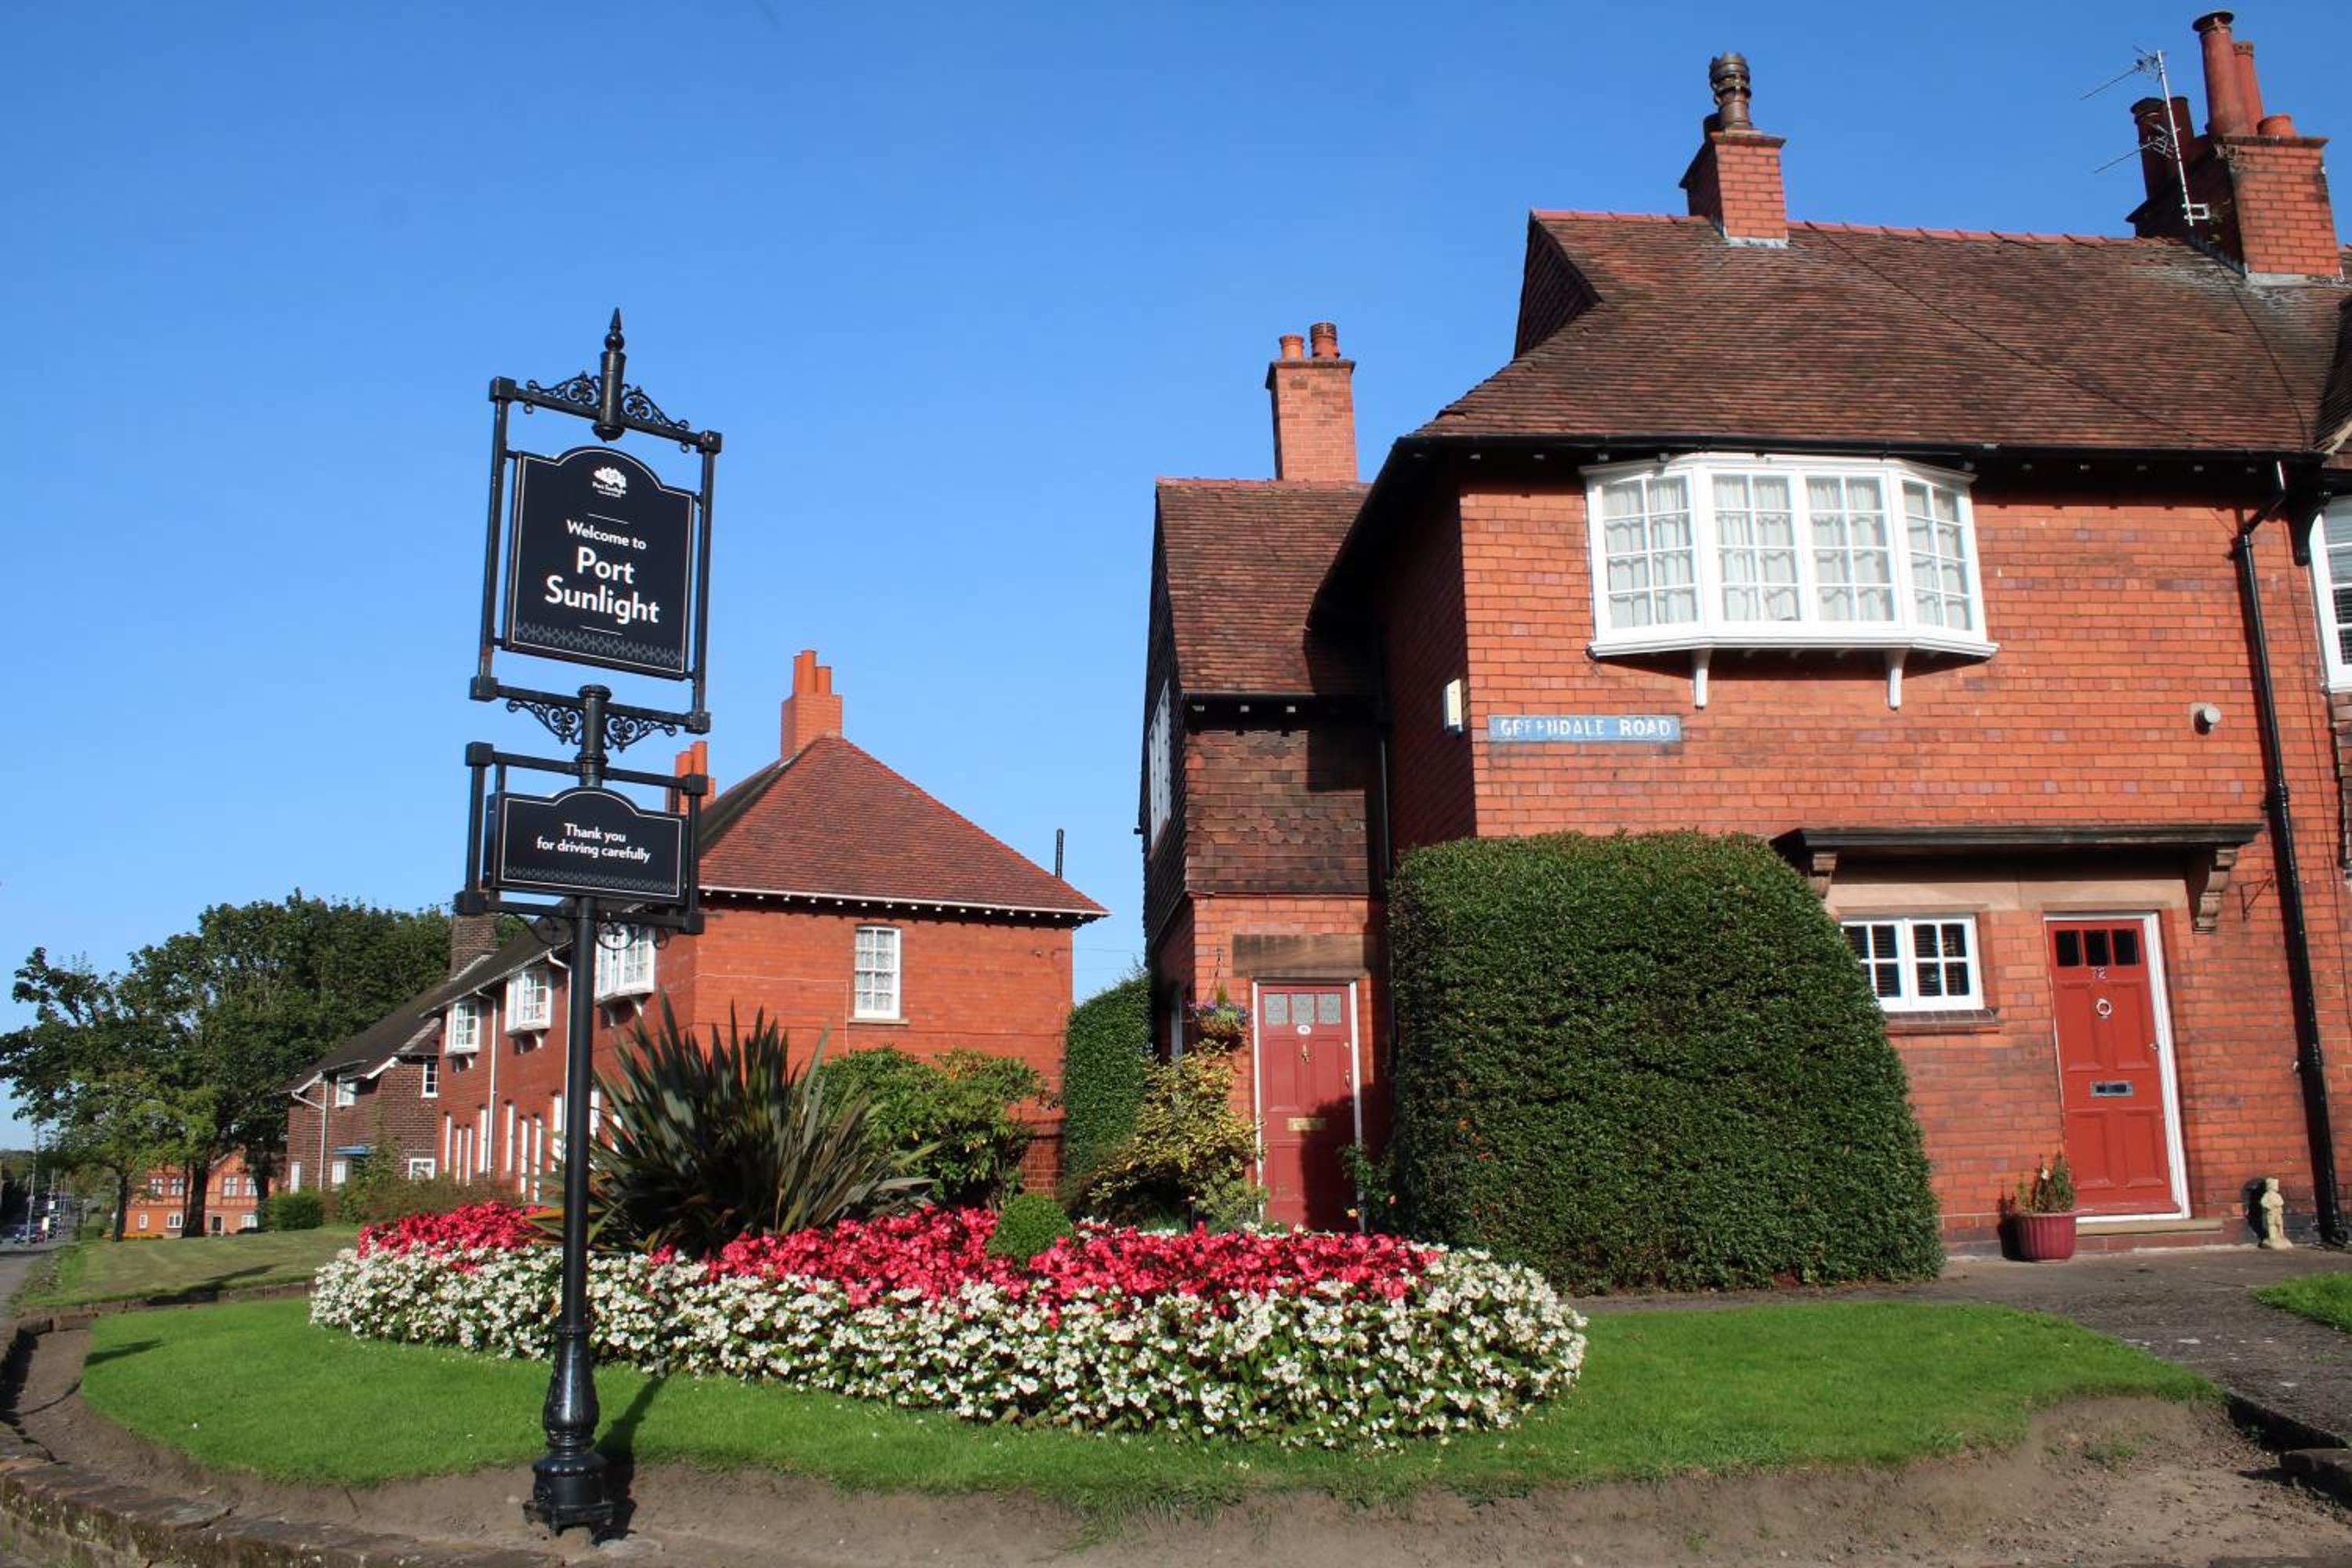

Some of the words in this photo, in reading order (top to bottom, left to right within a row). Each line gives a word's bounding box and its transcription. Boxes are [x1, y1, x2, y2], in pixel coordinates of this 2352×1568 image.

[566, 519, 630, 546] Welcome
[632, 538, 647, 550] to
[576, 546, 635, 584] Port
[544, 575, 660, 625] Sunlight
[1619, 719, 1671, 736] ROAD
[564, 822, 602, 840] Thank
[604, 831, 626, 844] you
[536, 837, 555, 851] for
[557, 839, 600, 858] driving
[601, 845, 652, 864] carefully
